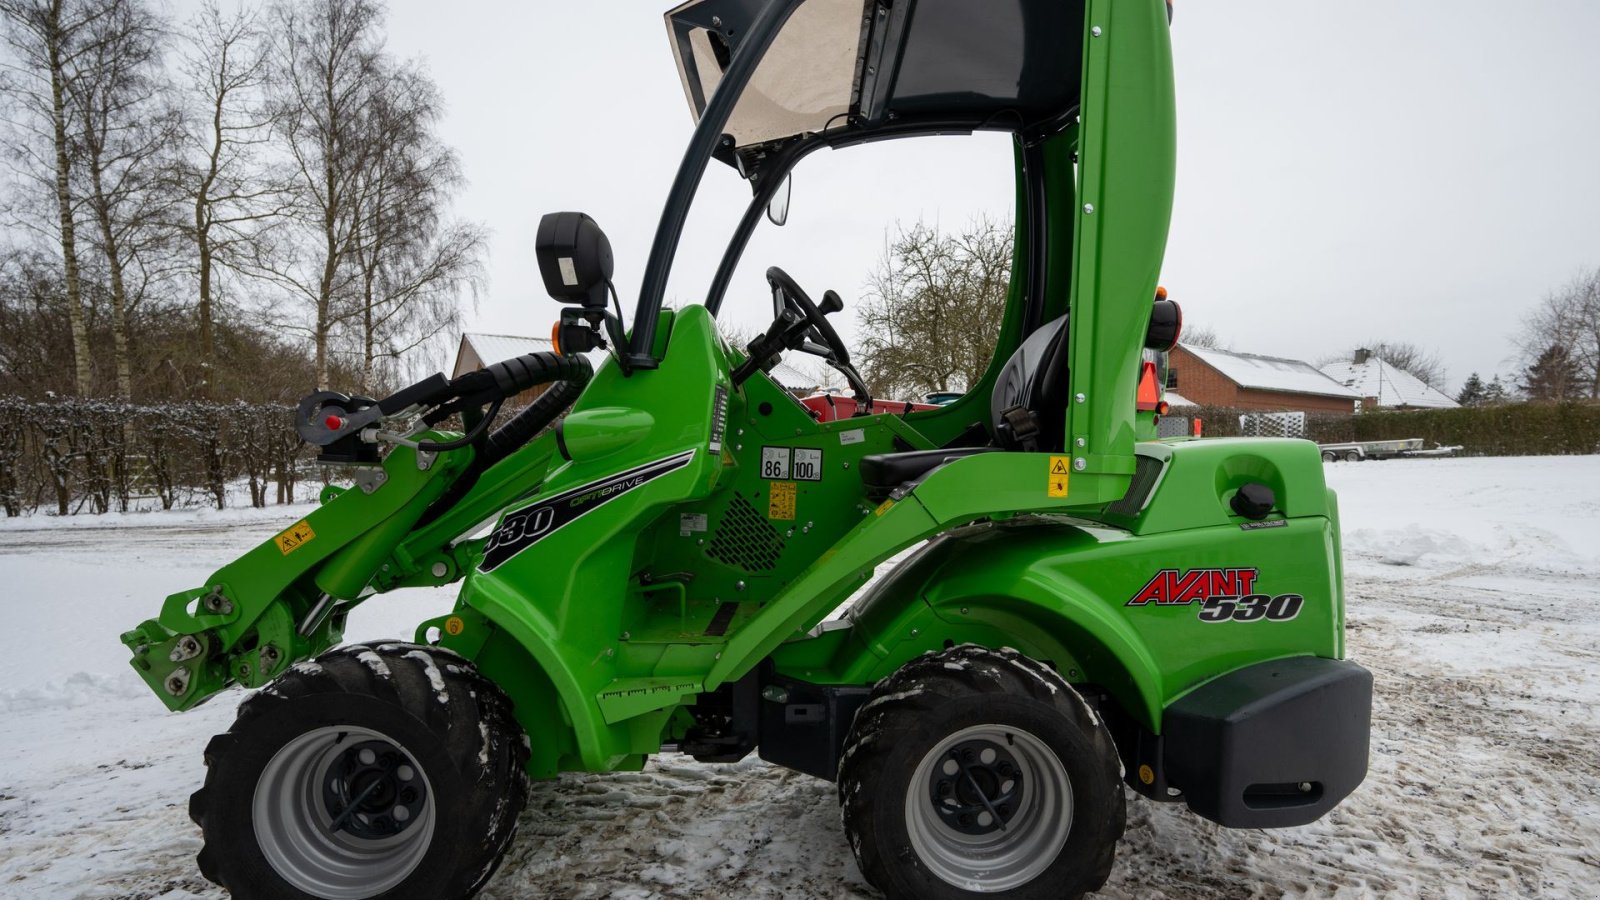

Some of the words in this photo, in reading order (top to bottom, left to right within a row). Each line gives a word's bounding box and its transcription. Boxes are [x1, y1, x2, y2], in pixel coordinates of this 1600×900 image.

[765, 461, 781, 477] 86
[795, 462, 813, 478] 100
[1124, 567, 1258, 606] AVANT
[1197, 593, 1304, 623] 530
